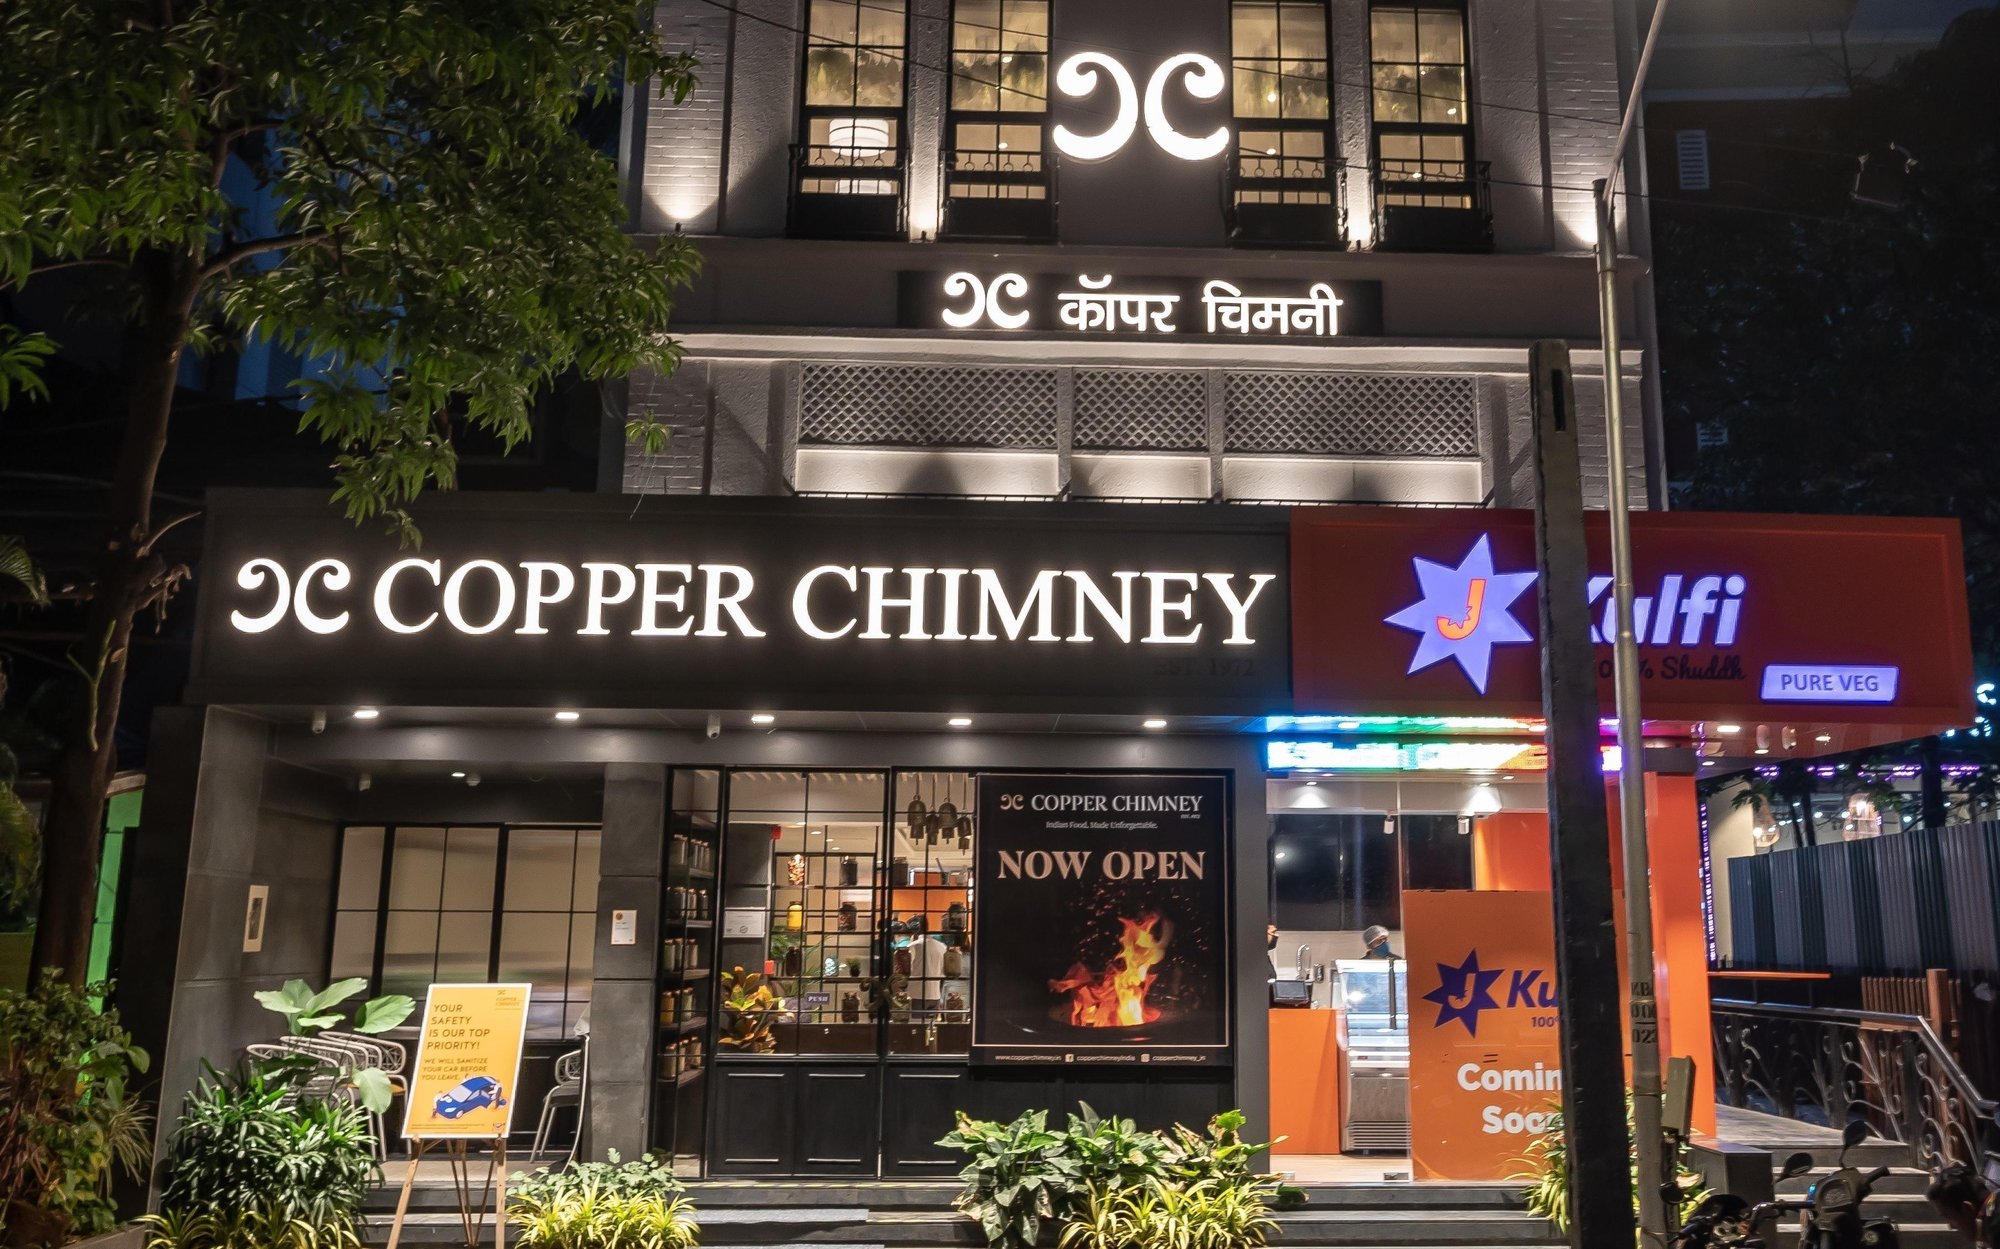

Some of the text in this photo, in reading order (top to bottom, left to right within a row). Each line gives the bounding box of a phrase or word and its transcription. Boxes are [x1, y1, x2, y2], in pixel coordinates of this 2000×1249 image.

[1058, 274, 1343, 335] कॉपर चिमनी
[373, 558, 1277, 645] COPPER CHIMNEY
[1661, 655, 1746, 680] Shuddh
[1781, 674, 1879, 692] PURE VEG
[1031, 794, 1203, 812] COPPER CHIMNEY
[998, 850, 1205, 880] NOW OPEN
[1507, 970, 1559, 1008] Ku
[431, 1016, 472, 1025] SAFETY
[434, 1004, 463, 1012] YOUR
[427, 1041, 480, 1050] PRIORITY!
[429, 1029, 490, 1037] IS OUR TOP
[1457, 1062, 1562, 1091] Comin
[1482, 1105, 1562, 1134] Soo
